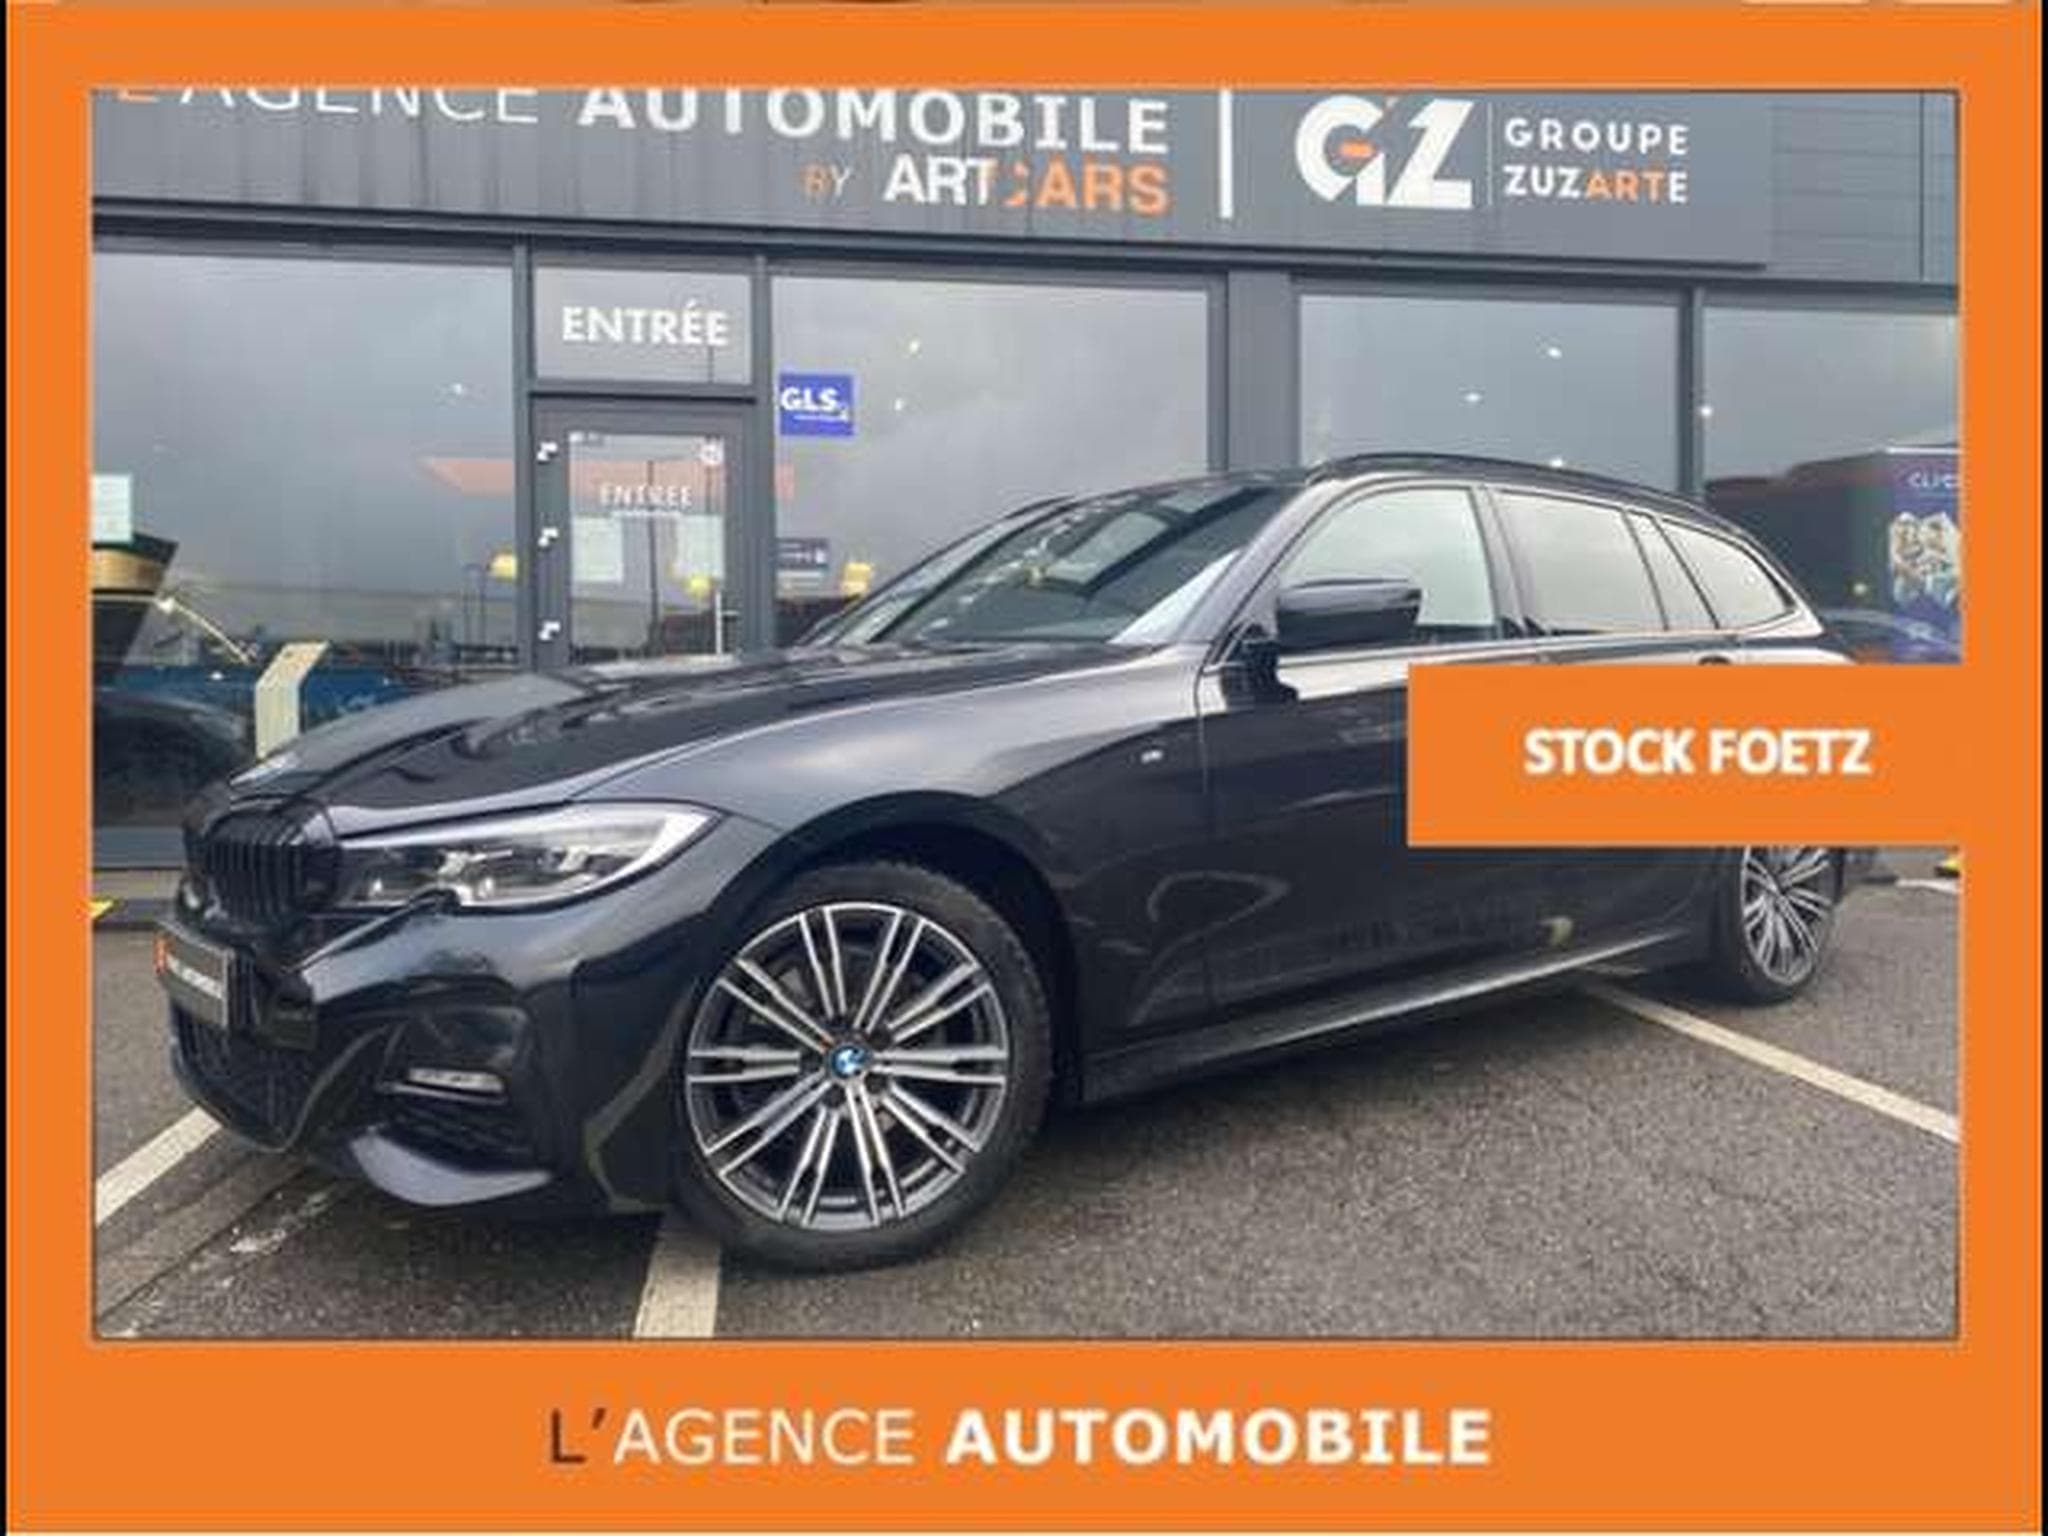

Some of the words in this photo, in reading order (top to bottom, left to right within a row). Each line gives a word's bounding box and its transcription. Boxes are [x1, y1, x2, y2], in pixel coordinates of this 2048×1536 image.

[577, 90, 1169, 153] AUTOMOBILE
[1504, 117, 1689, 155] GROUPE
[800, 162, 853, 200] BY
[1503, 165, 1689, 206] ZUZARTE
[561, 300, 728, 346] ENTRÉE
[781, 386, 838, 412] GLS
